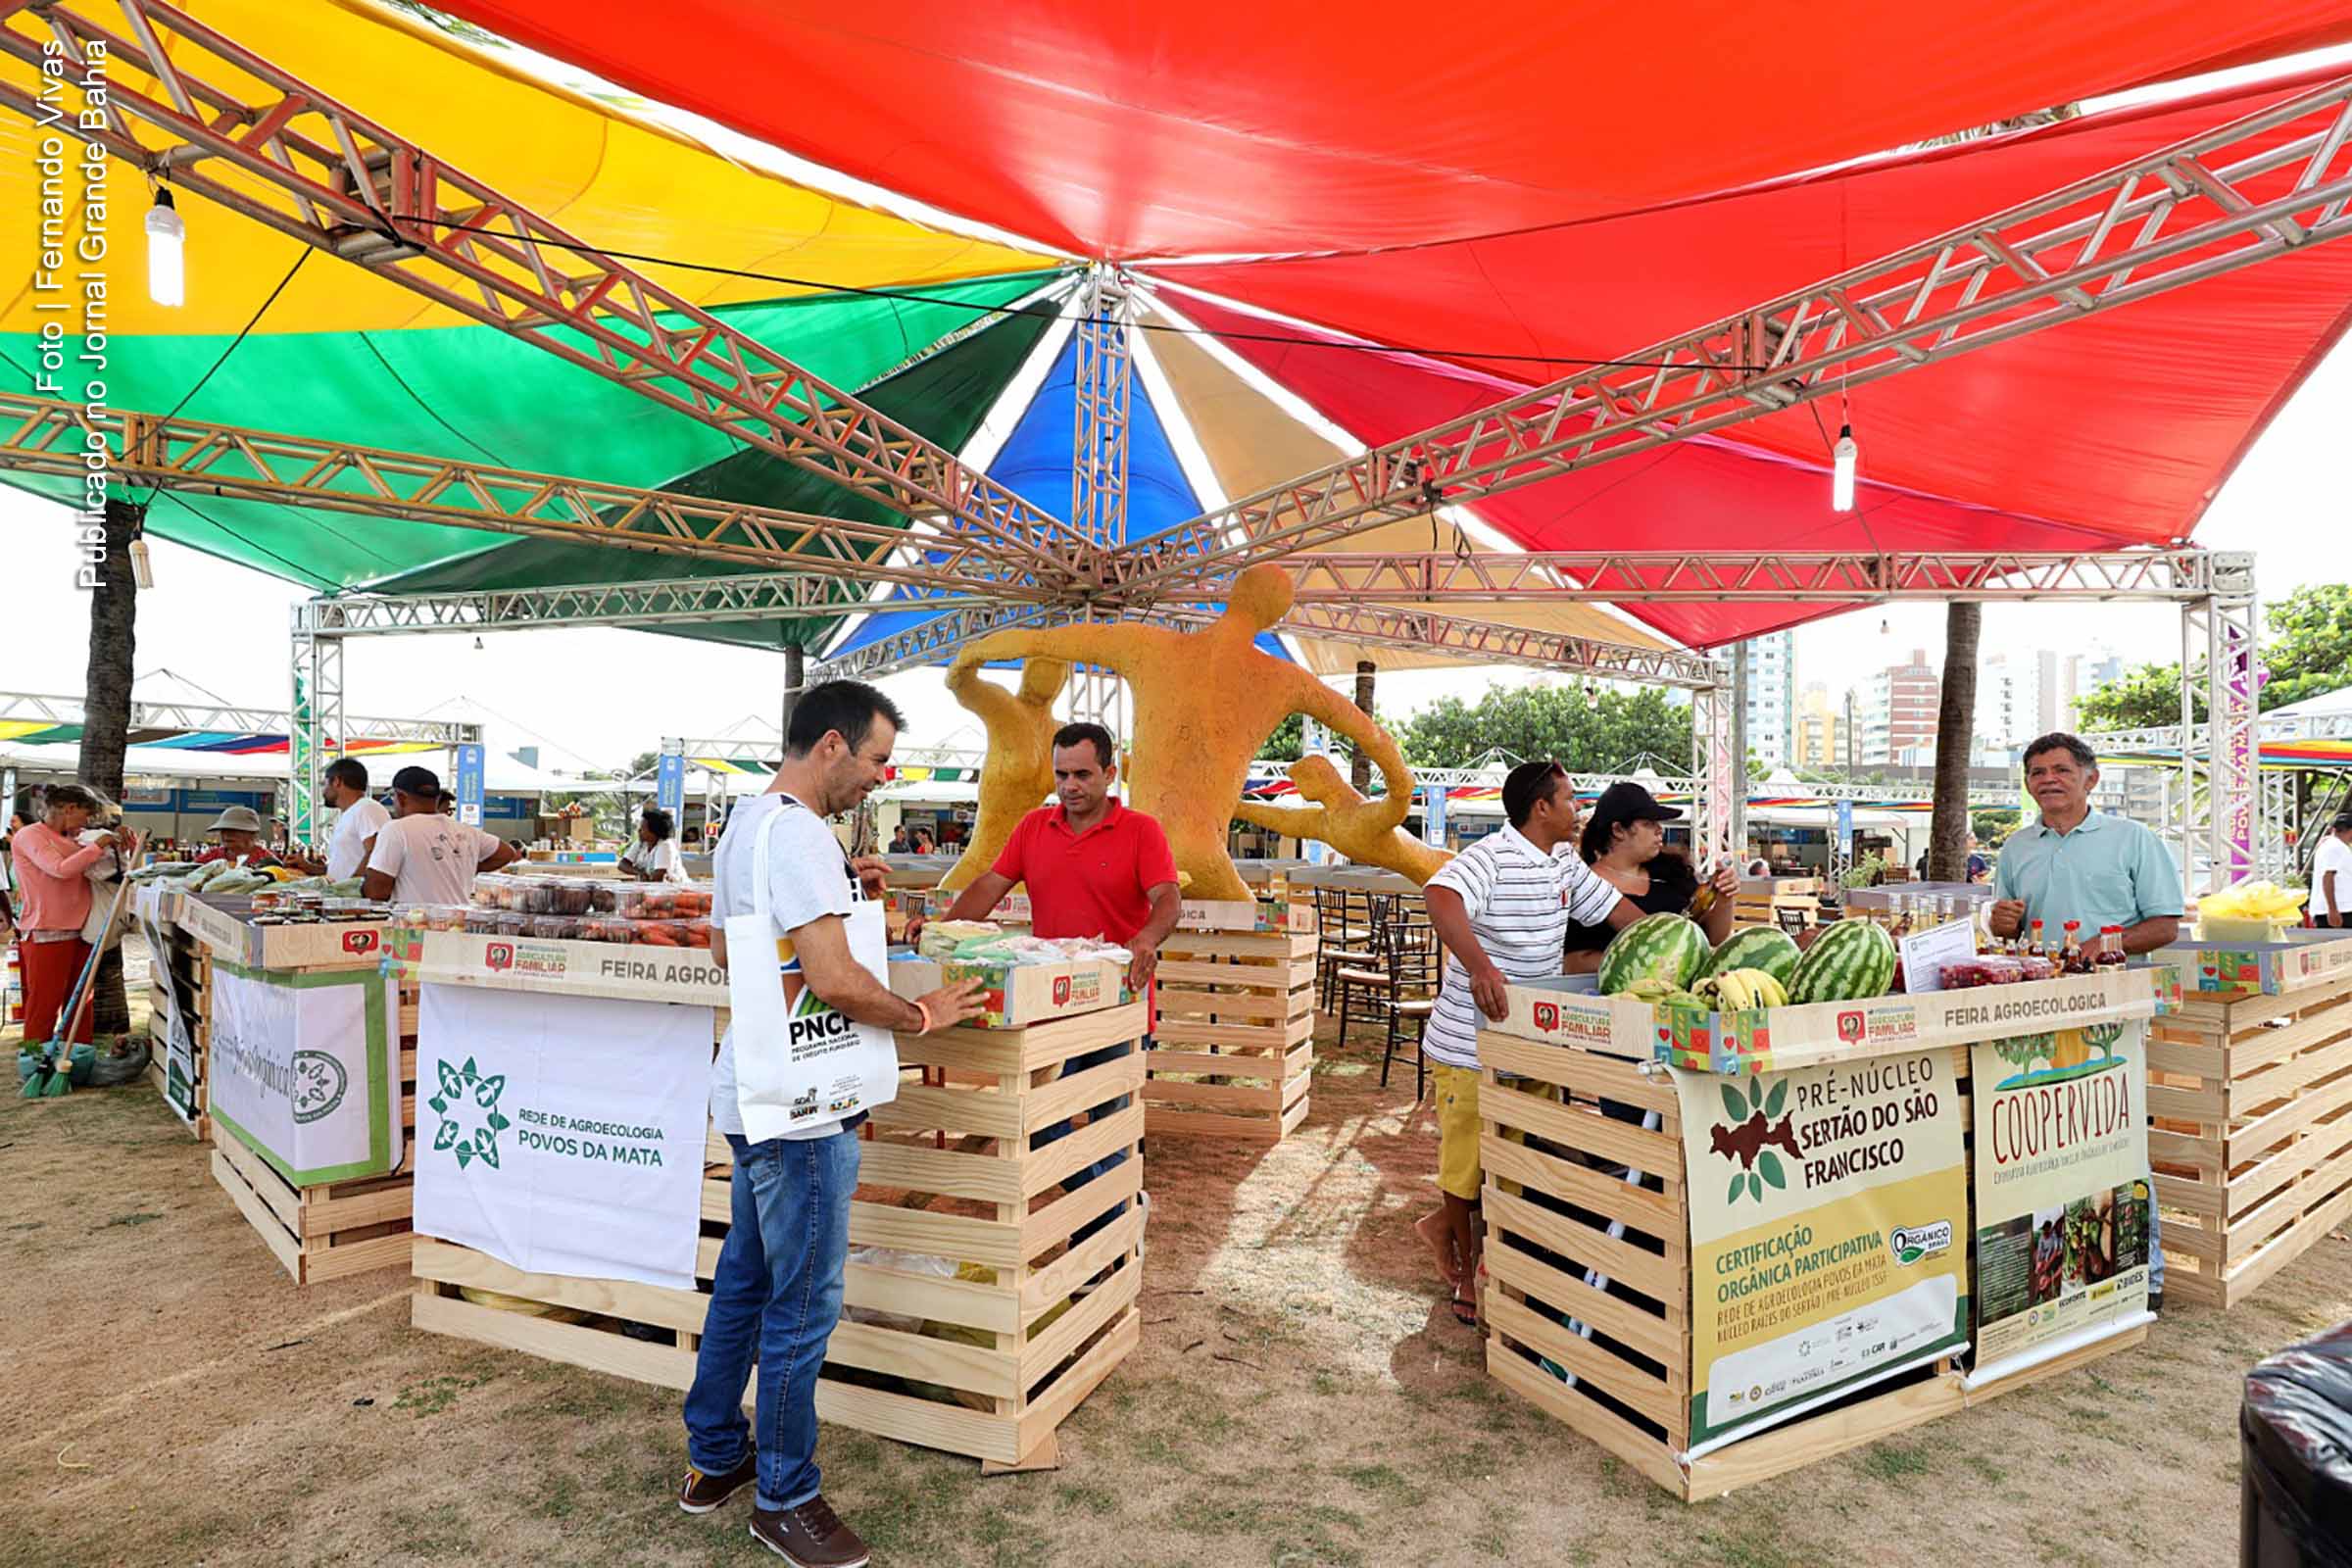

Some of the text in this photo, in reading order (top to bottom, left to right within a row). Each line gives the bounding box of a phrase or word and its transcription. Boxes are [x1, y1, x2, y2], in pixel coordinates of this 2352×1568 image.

[515, 959, 565, 973] FAMILIAR
[602, 959, 658, 981] FEIRA
[1868, 1021, 1916, 1037] FAMILIAR
[1944, 1006, 1989, 1027] FEIRA
[1993, 993, 2107, 1021] AGROECOLOGICA
[1796, 1056, 1935, 1112] PRÉ-NÚCLEO
[518, 1108, 664, 1141] REDE DE AGROECOLOGIA
[1800, 1087, 1938, 1151] SERTÃO DO SÃO
[1992, 1072, 2130, 1164] COOPERVIDA
[518, 1129, 663, 1167] POVOS DA MATA
[1804, 1138, 1905, 1190] FRANCISCO
[1716, 1223, 1813, 1275] CERTIFICAÇÃO
[1717, 1231, 1884, 1303] ORGÂNICA PARTICIPATIVA
[1717, 1306, 1740, 1327] REDE
[1759, 1279, 1822, 1312] AGROECOLOGIA
[1865, 1253, 1887, 1273] MATA
